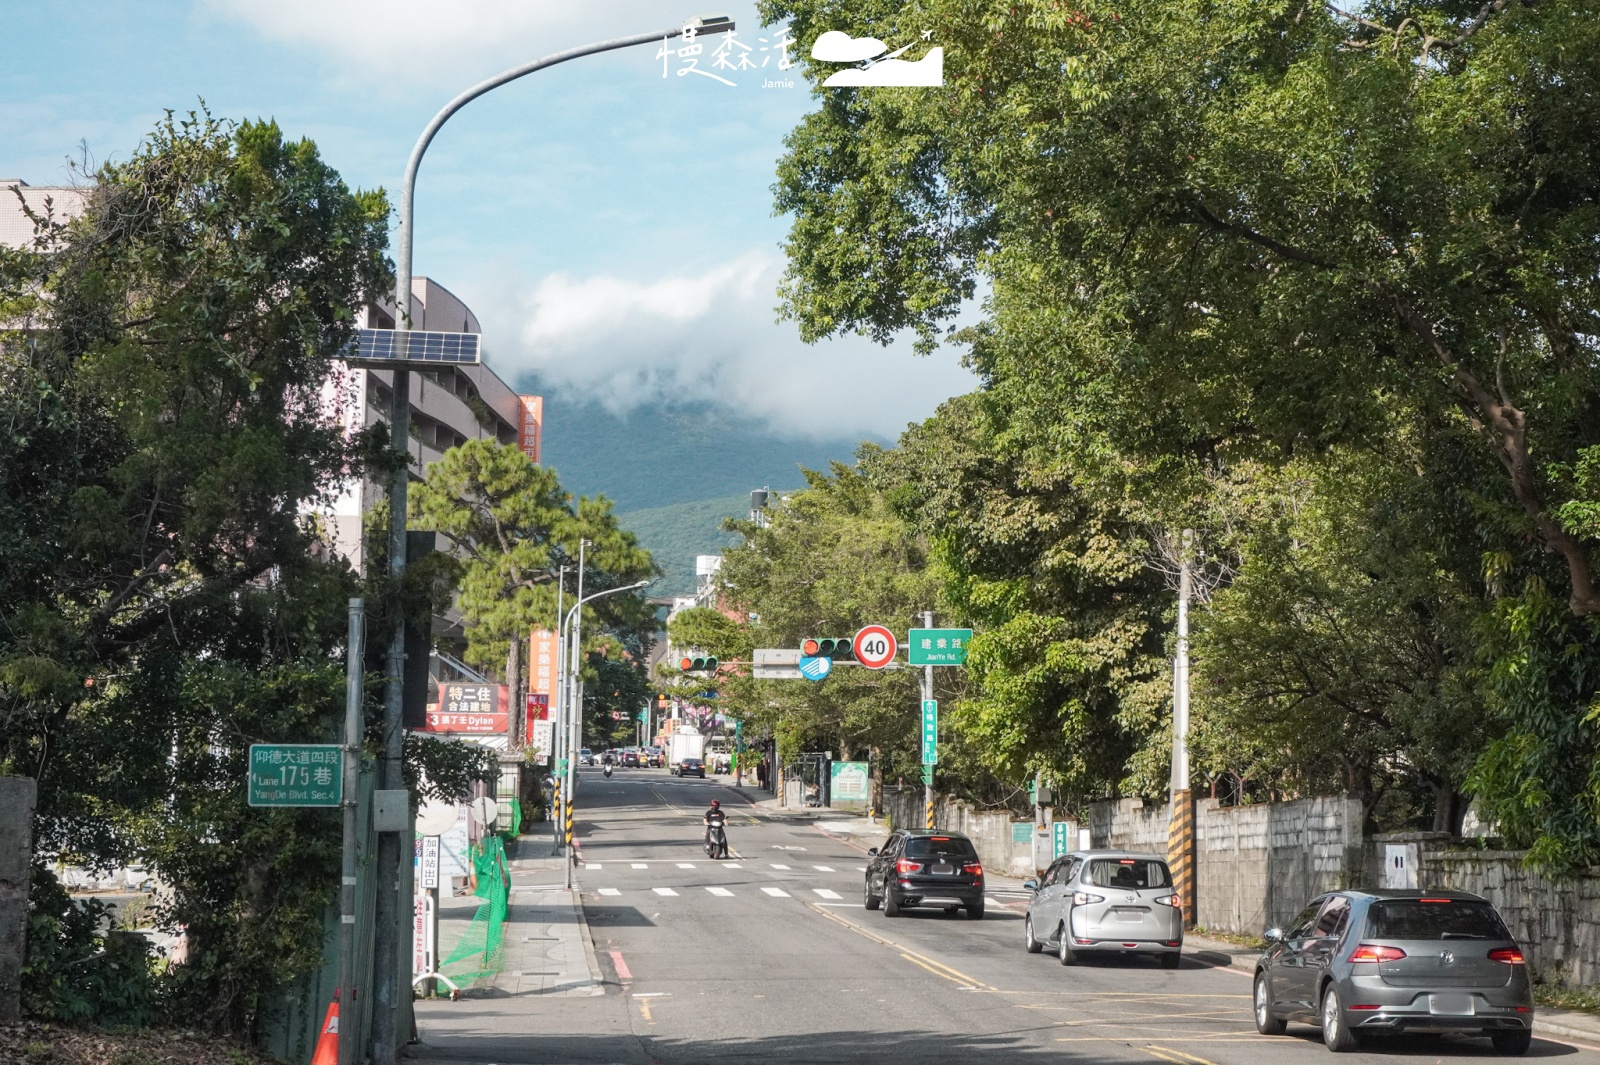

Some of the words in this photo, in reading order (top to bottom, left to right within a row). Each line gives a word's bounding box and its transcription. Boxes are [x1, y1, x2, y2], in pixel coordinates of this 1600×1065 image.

[524, 402, 537, 457] 家樂福超市
[864, 640, 885, 655] 40
[921, 638, 962, 649] 建業路
[926, 653, 946, 661] JianYe
[448, 687, 491, 701] 特二住
[448, 701, 491, 712] 合法建地
[468, 716, 494, 727] Dylan
[254, 750, 339, 765] 仰德大道四段
[258, 776, 279, 786] Lane
[255, 789, 287, 801] YangDe
[288, 790, 308, 800] Blvd.
[424, 838, 437, 886] 加油站出口
